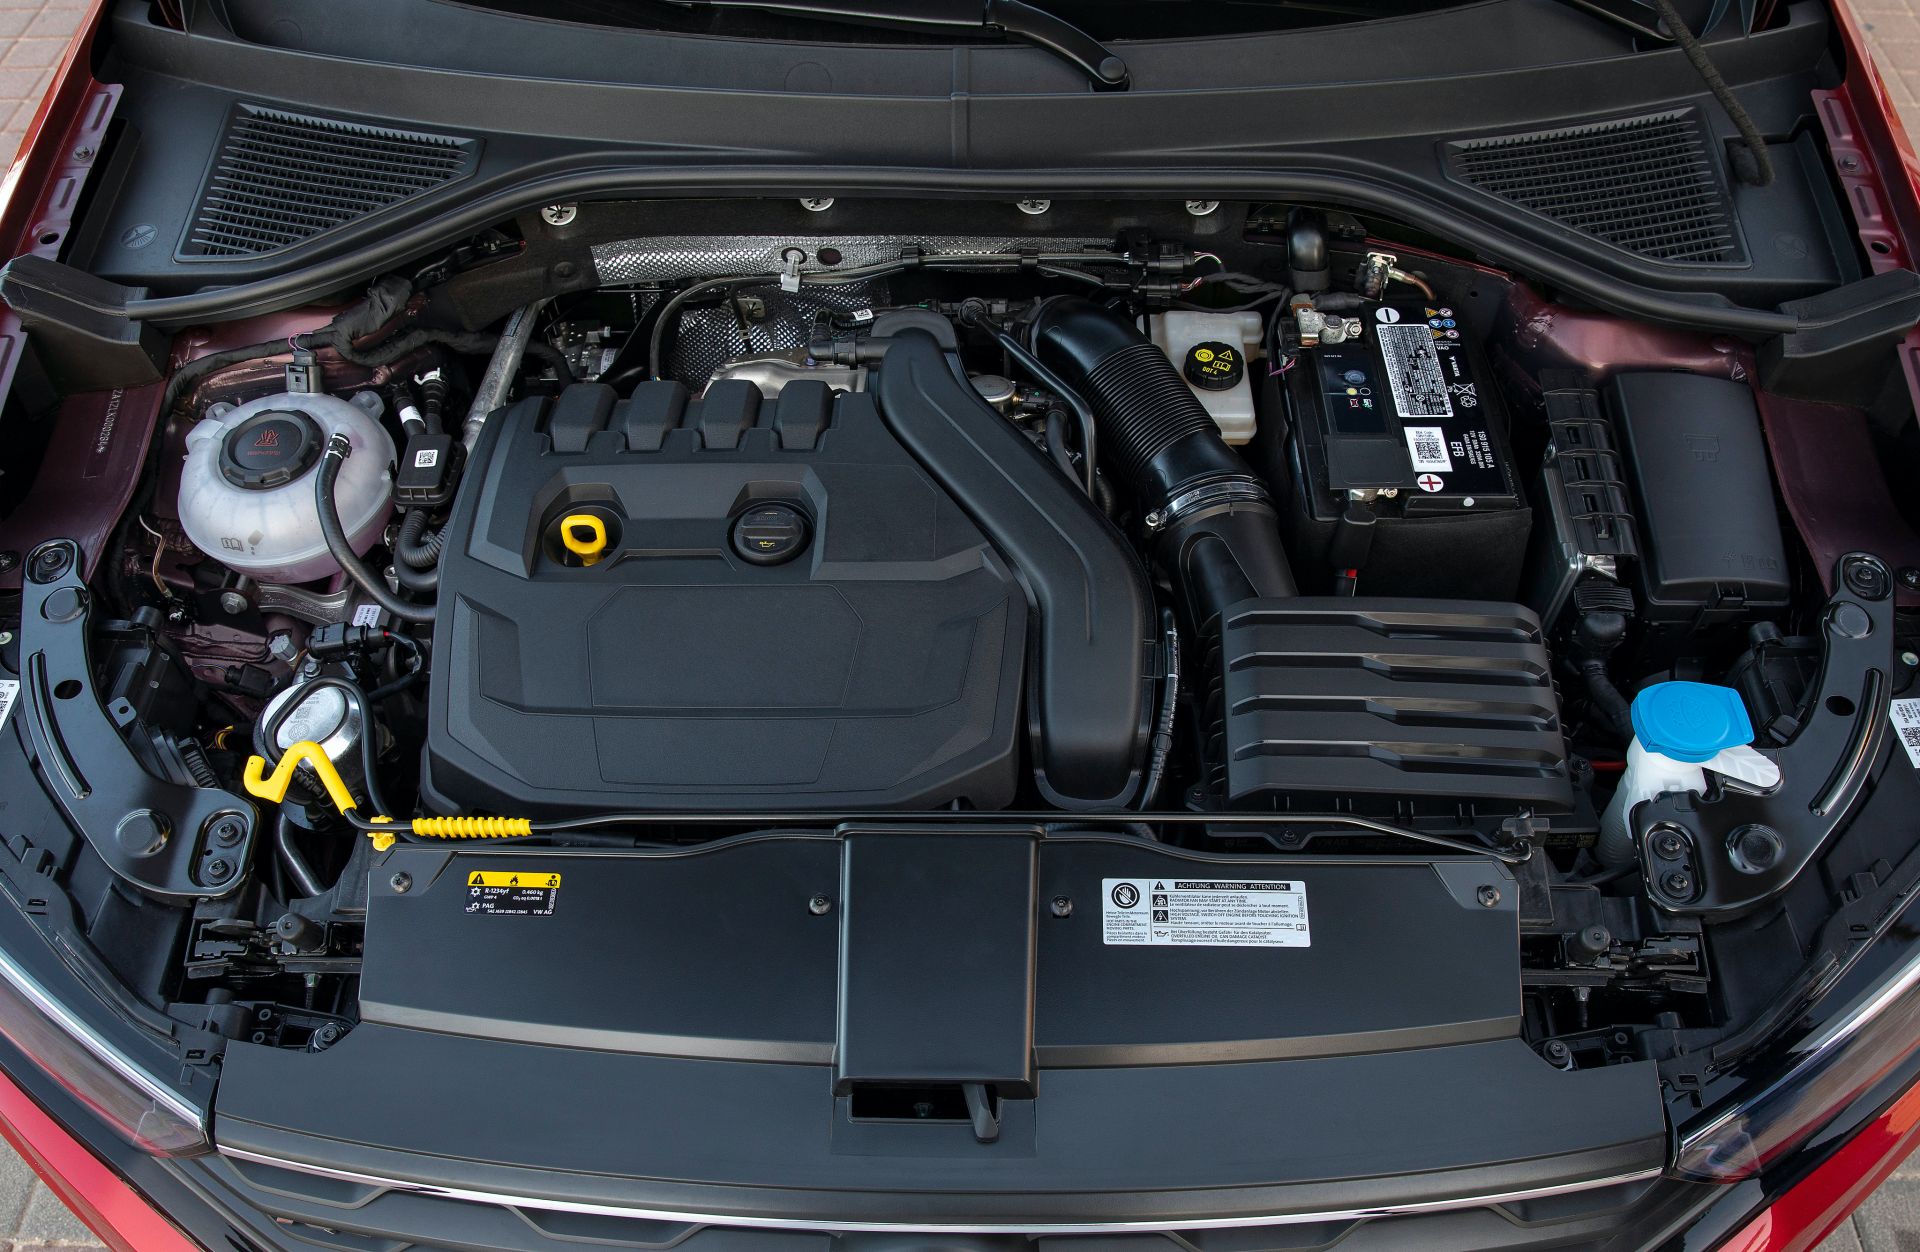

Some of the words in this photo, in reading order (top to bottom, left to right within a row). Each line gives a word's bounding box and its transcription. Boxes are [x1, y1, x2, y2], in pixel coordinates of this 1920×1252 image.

[1450, 441, 1464, 456] EFB
[1481, 441, 1490, 452] 915
[1484, 453, 1493, 463] 105
